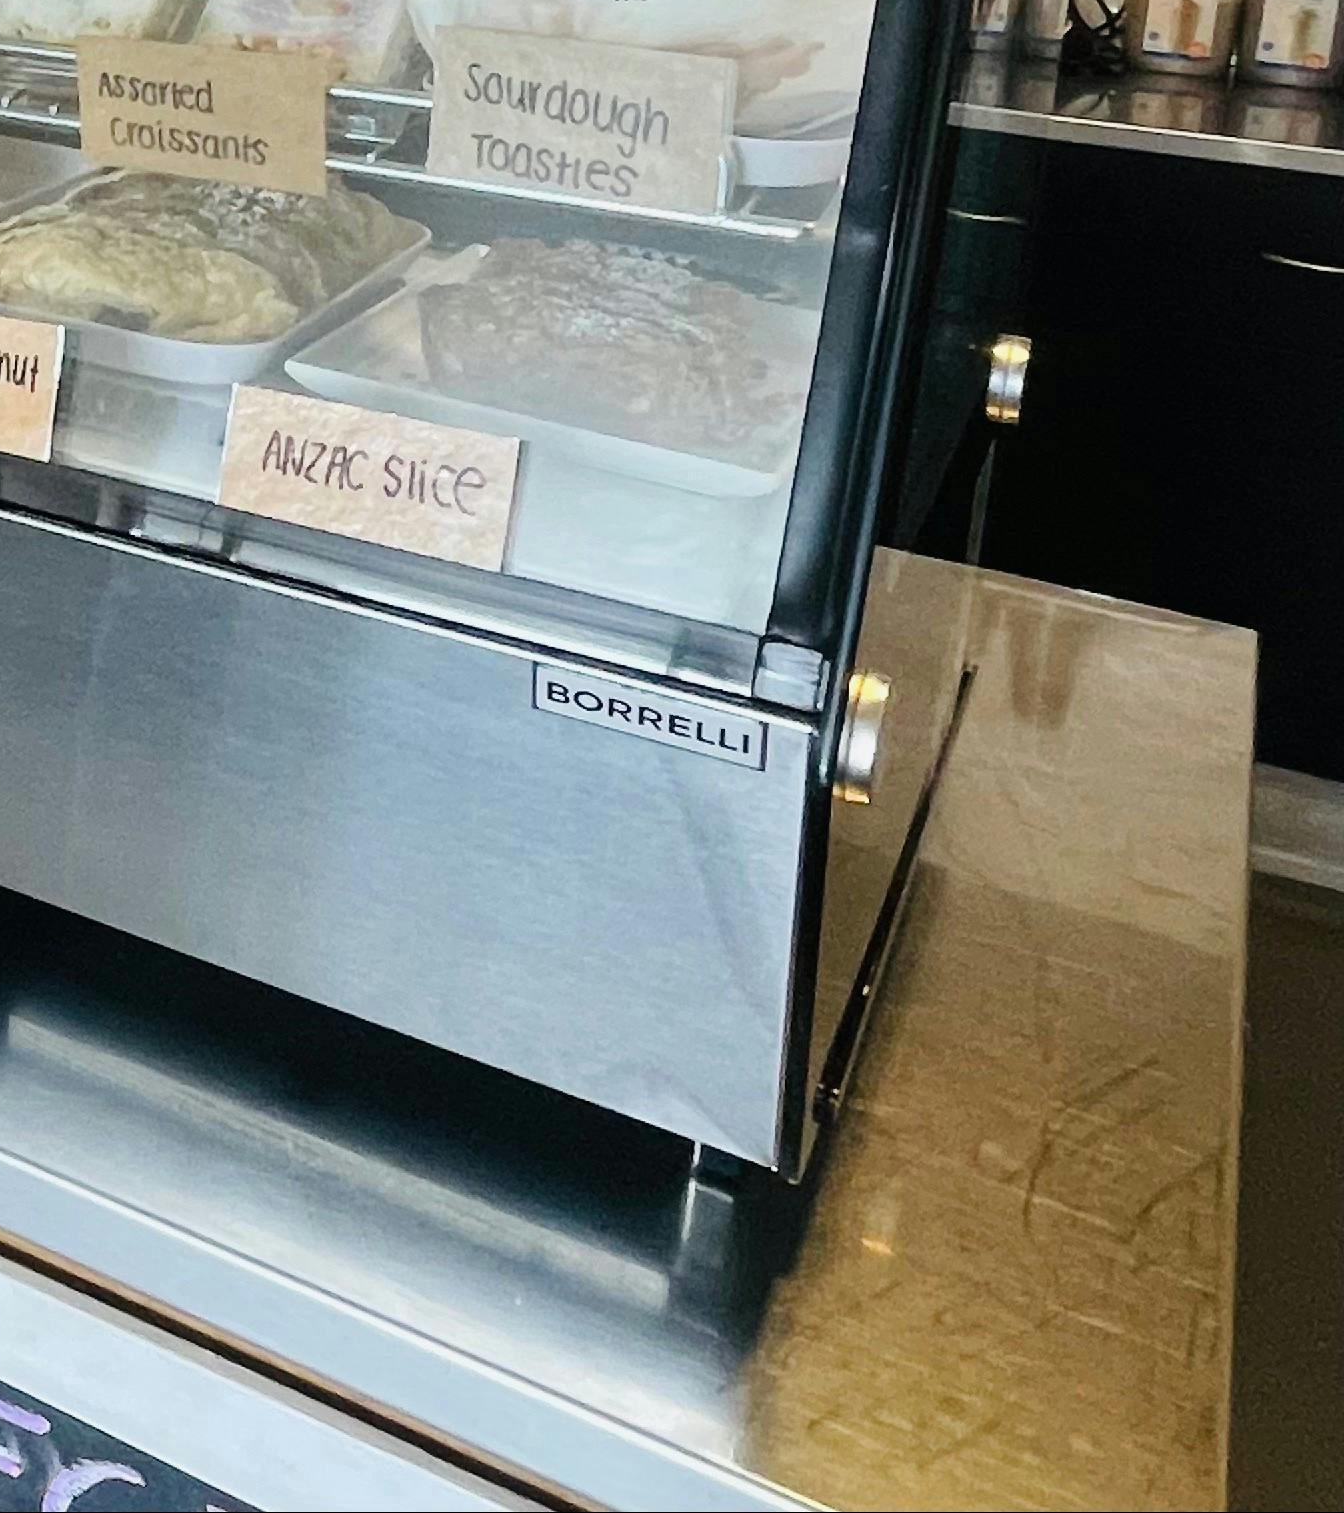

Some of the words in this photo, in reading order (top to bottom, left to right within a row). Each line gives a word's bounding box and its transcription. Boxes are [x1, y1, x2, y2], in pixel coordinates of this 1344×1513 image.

[98, 72, 215, 114] Assorted
[464, 62, 670, 159] Sourdough
[110, 116, 270, 166] Croissants
[471, 133, 640, 198] Toasties
[260, 431, 369, 491] ANZAC
[546, 681, 750, 754] BORRELLI
